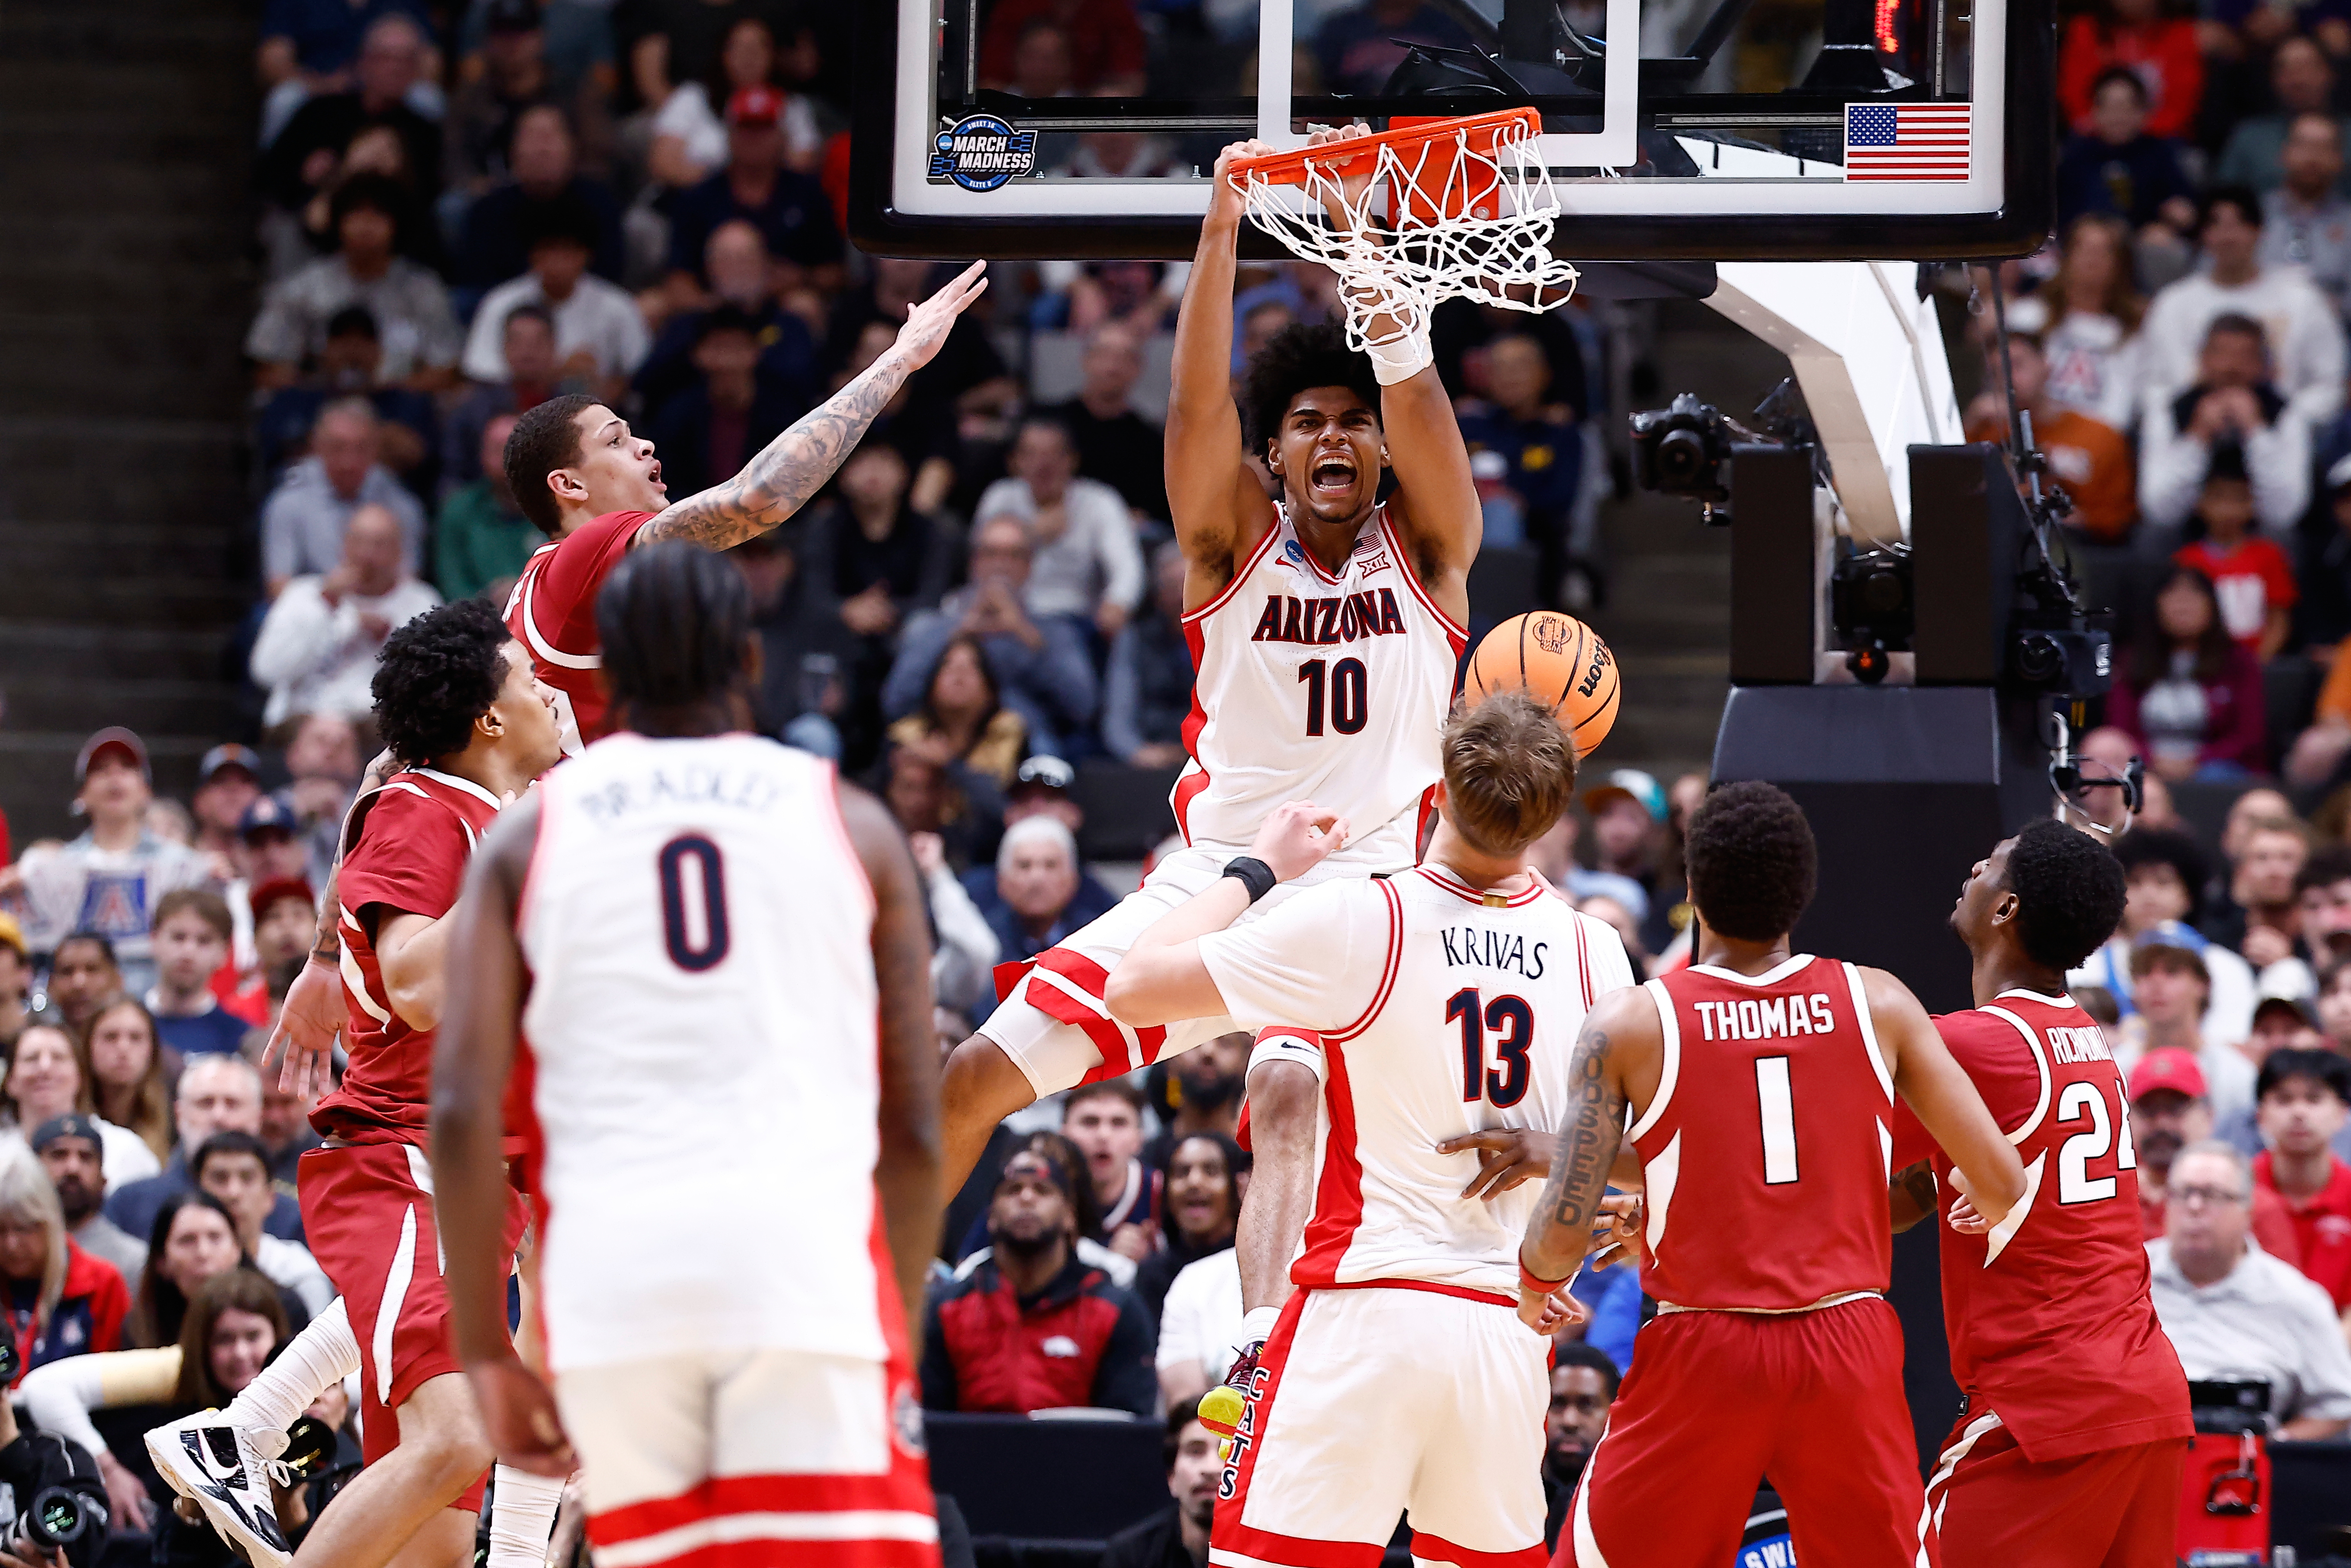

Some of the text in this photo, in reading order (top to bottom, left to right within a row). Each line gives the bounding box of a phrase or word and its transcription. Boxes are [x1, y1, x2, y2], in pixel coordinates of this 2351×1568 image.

[952, 136, 1008, 152] MARCH
[958, 153, 1032, 168] MADNESS
[1356, 550, 1392, 580] XII
[1251, 588, 1407, 645] ARIZONA
[1298, 657, 1368, 737] 10
[657, 833, 731, 973] 0
[1440, 927, 1548, 980] KRIVAS
[1693, 993, 1836, 1041] THOMAS
[1445, 987, 1534, 1109] 13
[1754, 1055, 1799, 1185] 1
[1218, 1367, 1271, 1500] CATS
